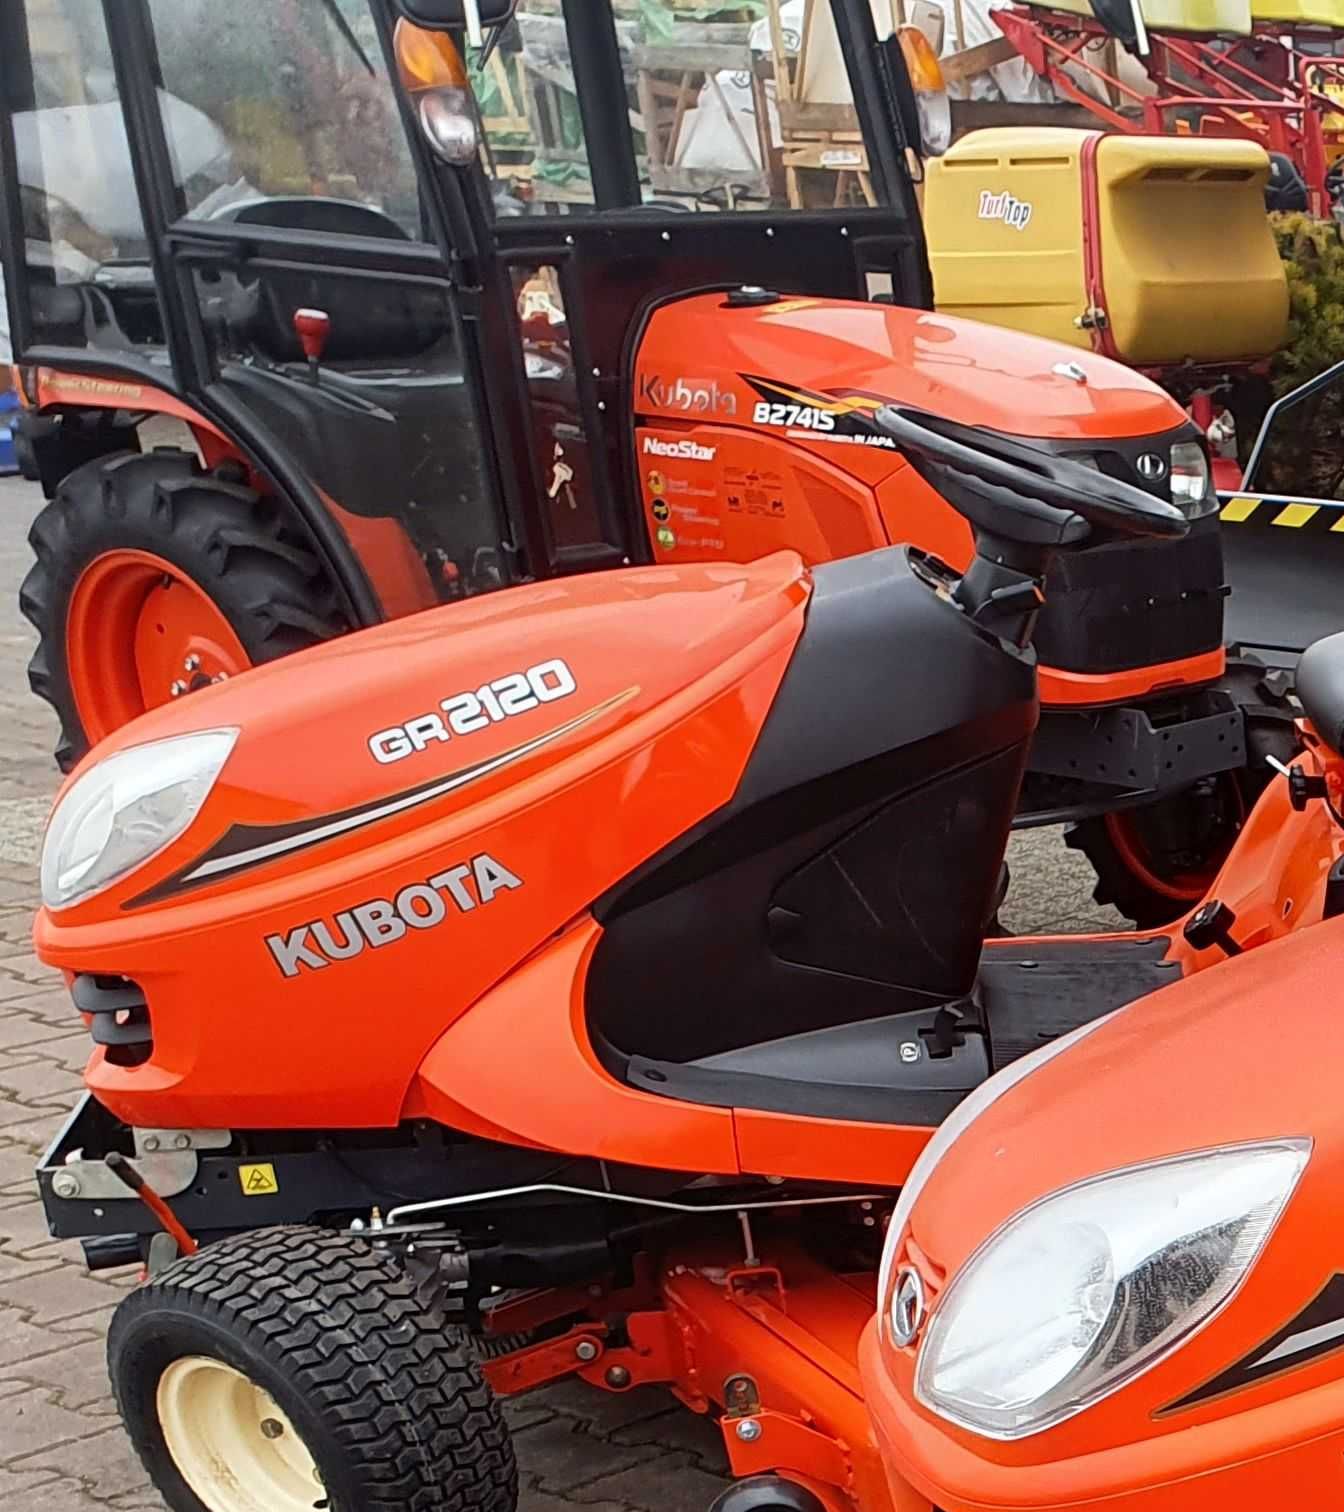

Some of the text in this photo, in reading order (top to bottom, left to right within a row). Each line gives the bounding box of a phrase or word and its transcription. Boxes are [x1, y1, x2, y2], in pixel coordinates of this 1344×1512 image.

[640, 373, 737, 416] Kubota
[752, 401, 836, 432] B2741S
[643, 436, 717, 462] NeoStar
[865, 435, 897, 449] JAPA
[368, 658, 578, 765] GR2120
[263, 850, 526, 978] KUBOTA
